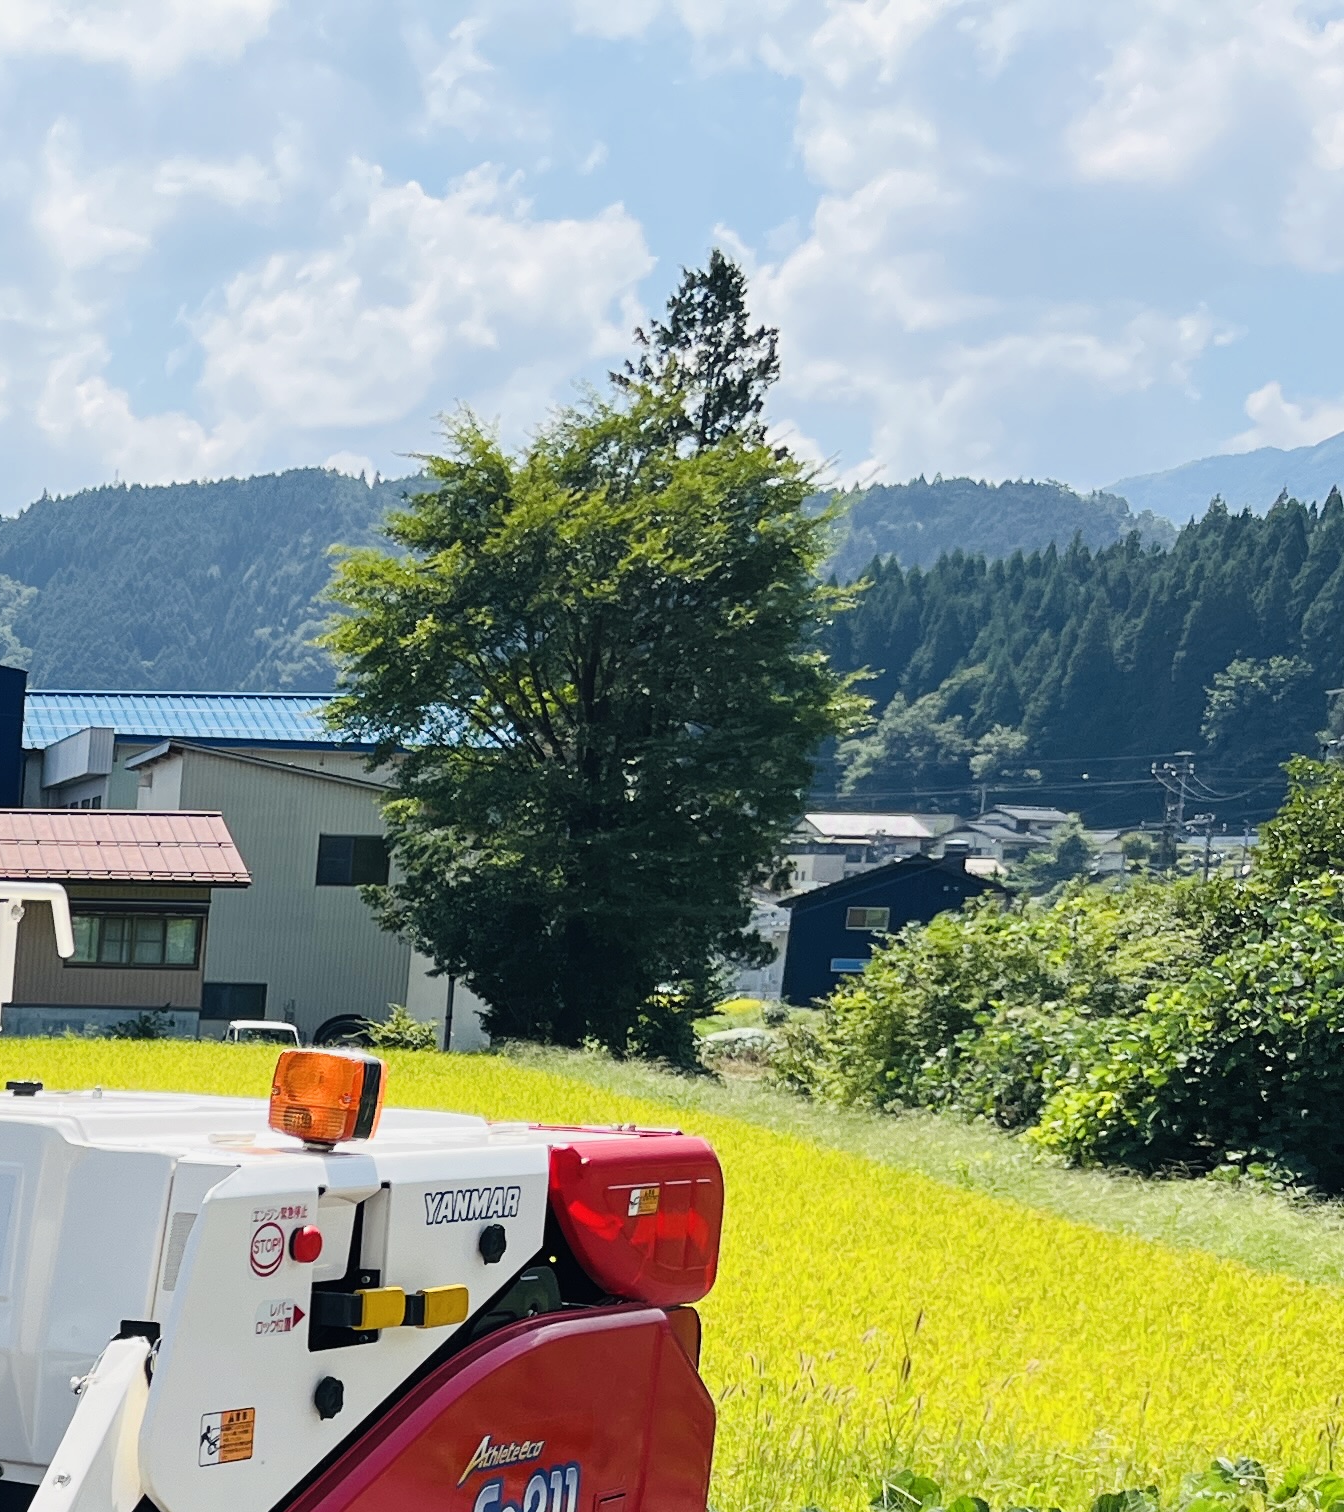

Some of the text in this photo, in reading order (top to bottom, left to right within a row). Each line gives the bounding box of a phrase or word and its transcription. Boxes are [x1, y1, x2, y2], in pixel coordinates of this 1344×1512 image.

[424, 1186, 521, 1225] YANMAR
[270, 1302, 292, 1317] レバー
